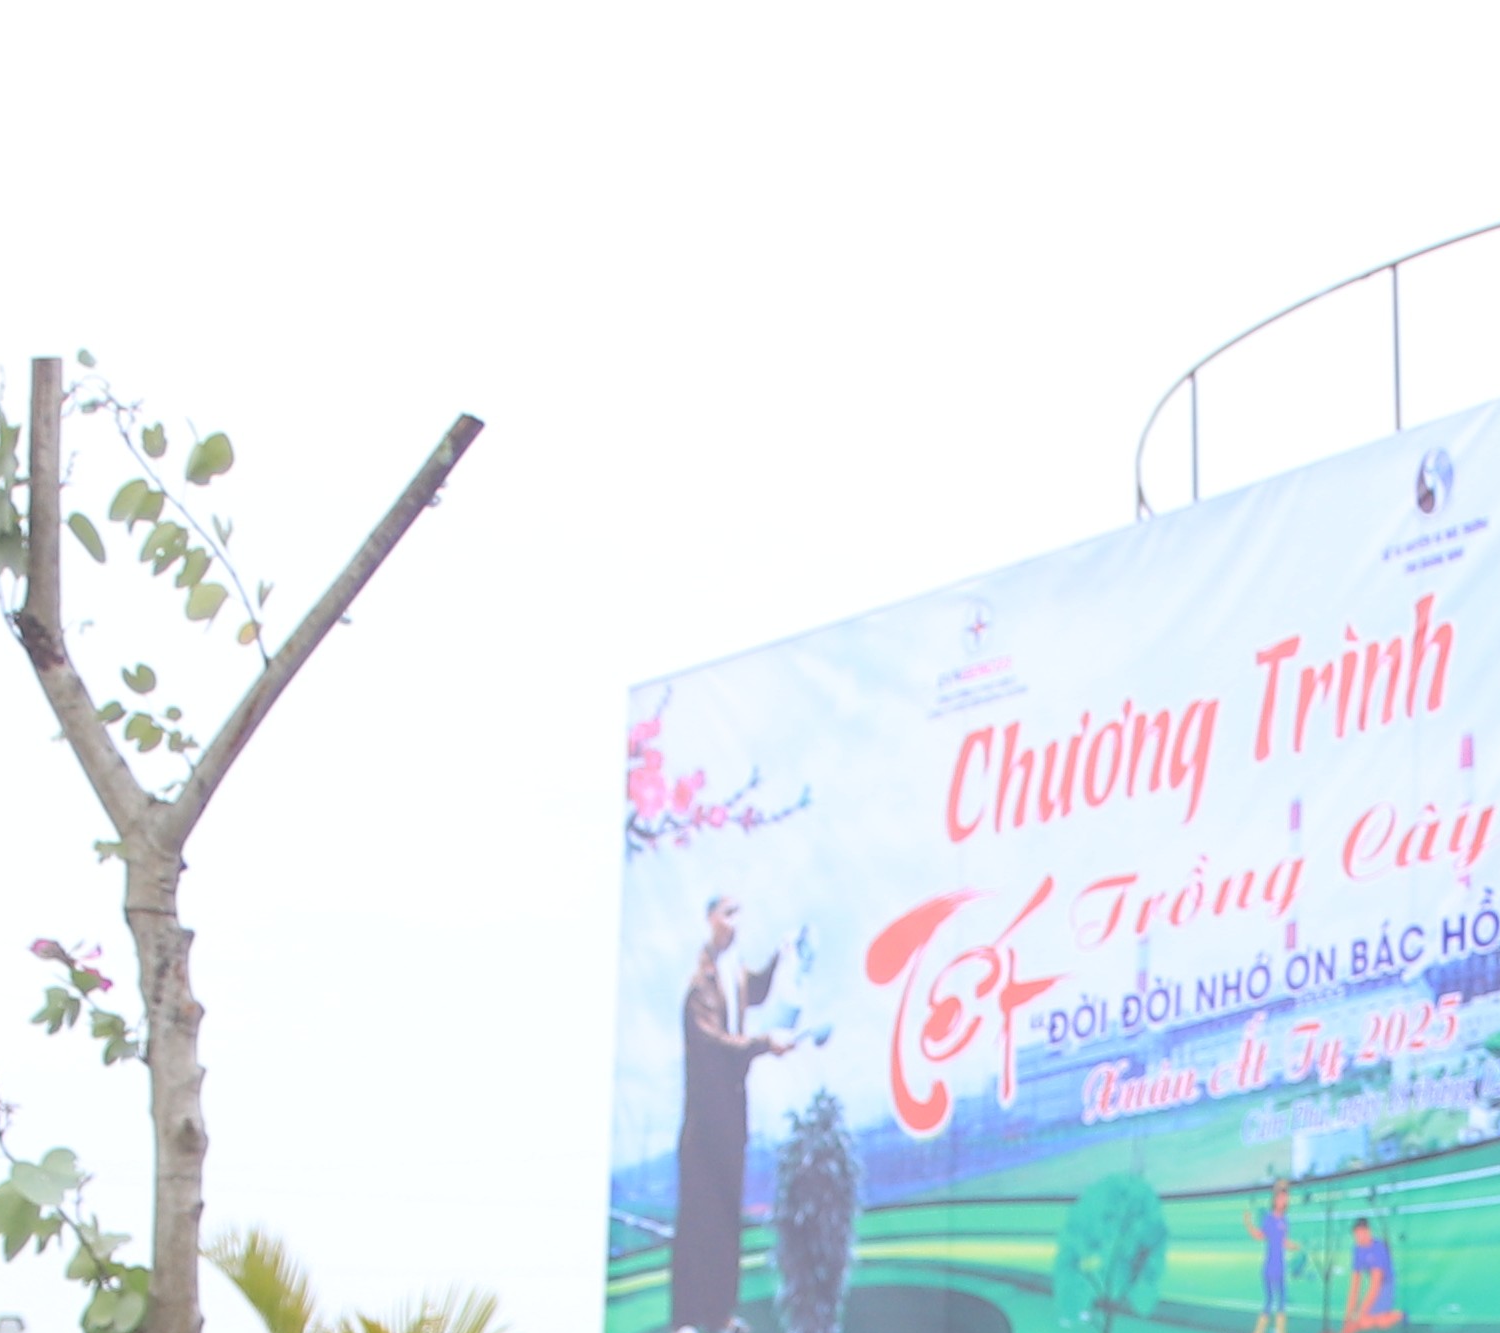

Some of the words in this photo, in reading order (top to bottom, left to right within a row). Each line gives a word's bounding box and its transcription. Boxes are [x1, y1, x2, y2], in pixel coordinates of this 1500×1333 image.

[946, 699, 1219, 843] Chương
[1254, 593, 1453, 761] Trình
[865, 875, 1077, 1131] Tết
[1076, 853, 1304, 951] Trồng
[1341, 803, 1495, 881] Cây
[1121, 980, 1182, 1029] ĐỜI
[1198, 950, 1274, 1012] NHỚ
[1286, 942, 1336, 990] ƠN
[1351, 918, 1425, 972] BÁC
[1353, 993, 1461, 1064] 2025
